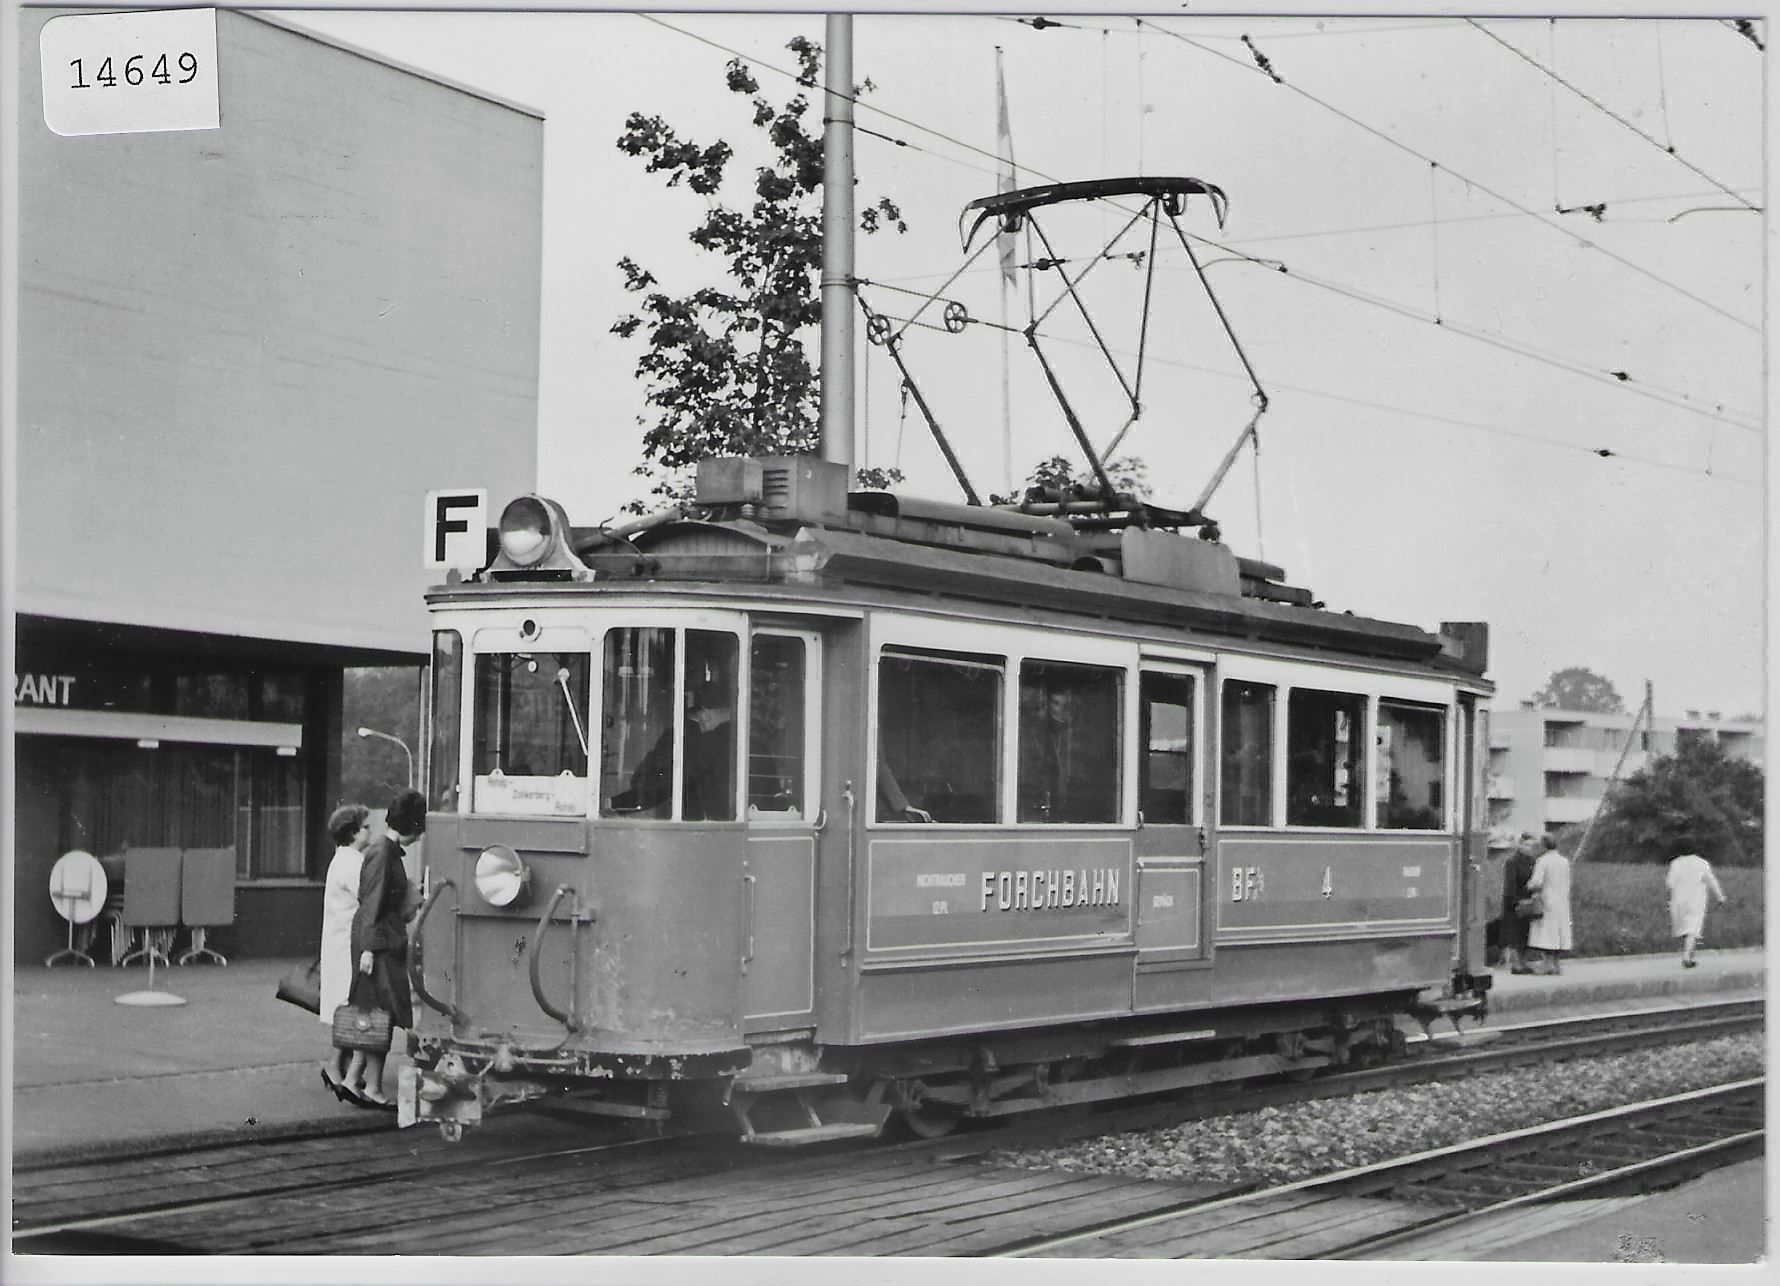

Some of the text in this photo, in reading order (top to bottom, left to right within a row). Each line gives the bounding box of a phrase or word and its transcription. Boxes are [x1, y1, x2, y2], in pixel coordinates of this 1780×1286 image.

[70, 52, 198, 89] 14649
[435, 494, 479, 562] F
[15, 673, 76, 706] ANT
[981, 868, 1120, 912] FORCHBAHN
[1322, 866, 1333, 900] 4
